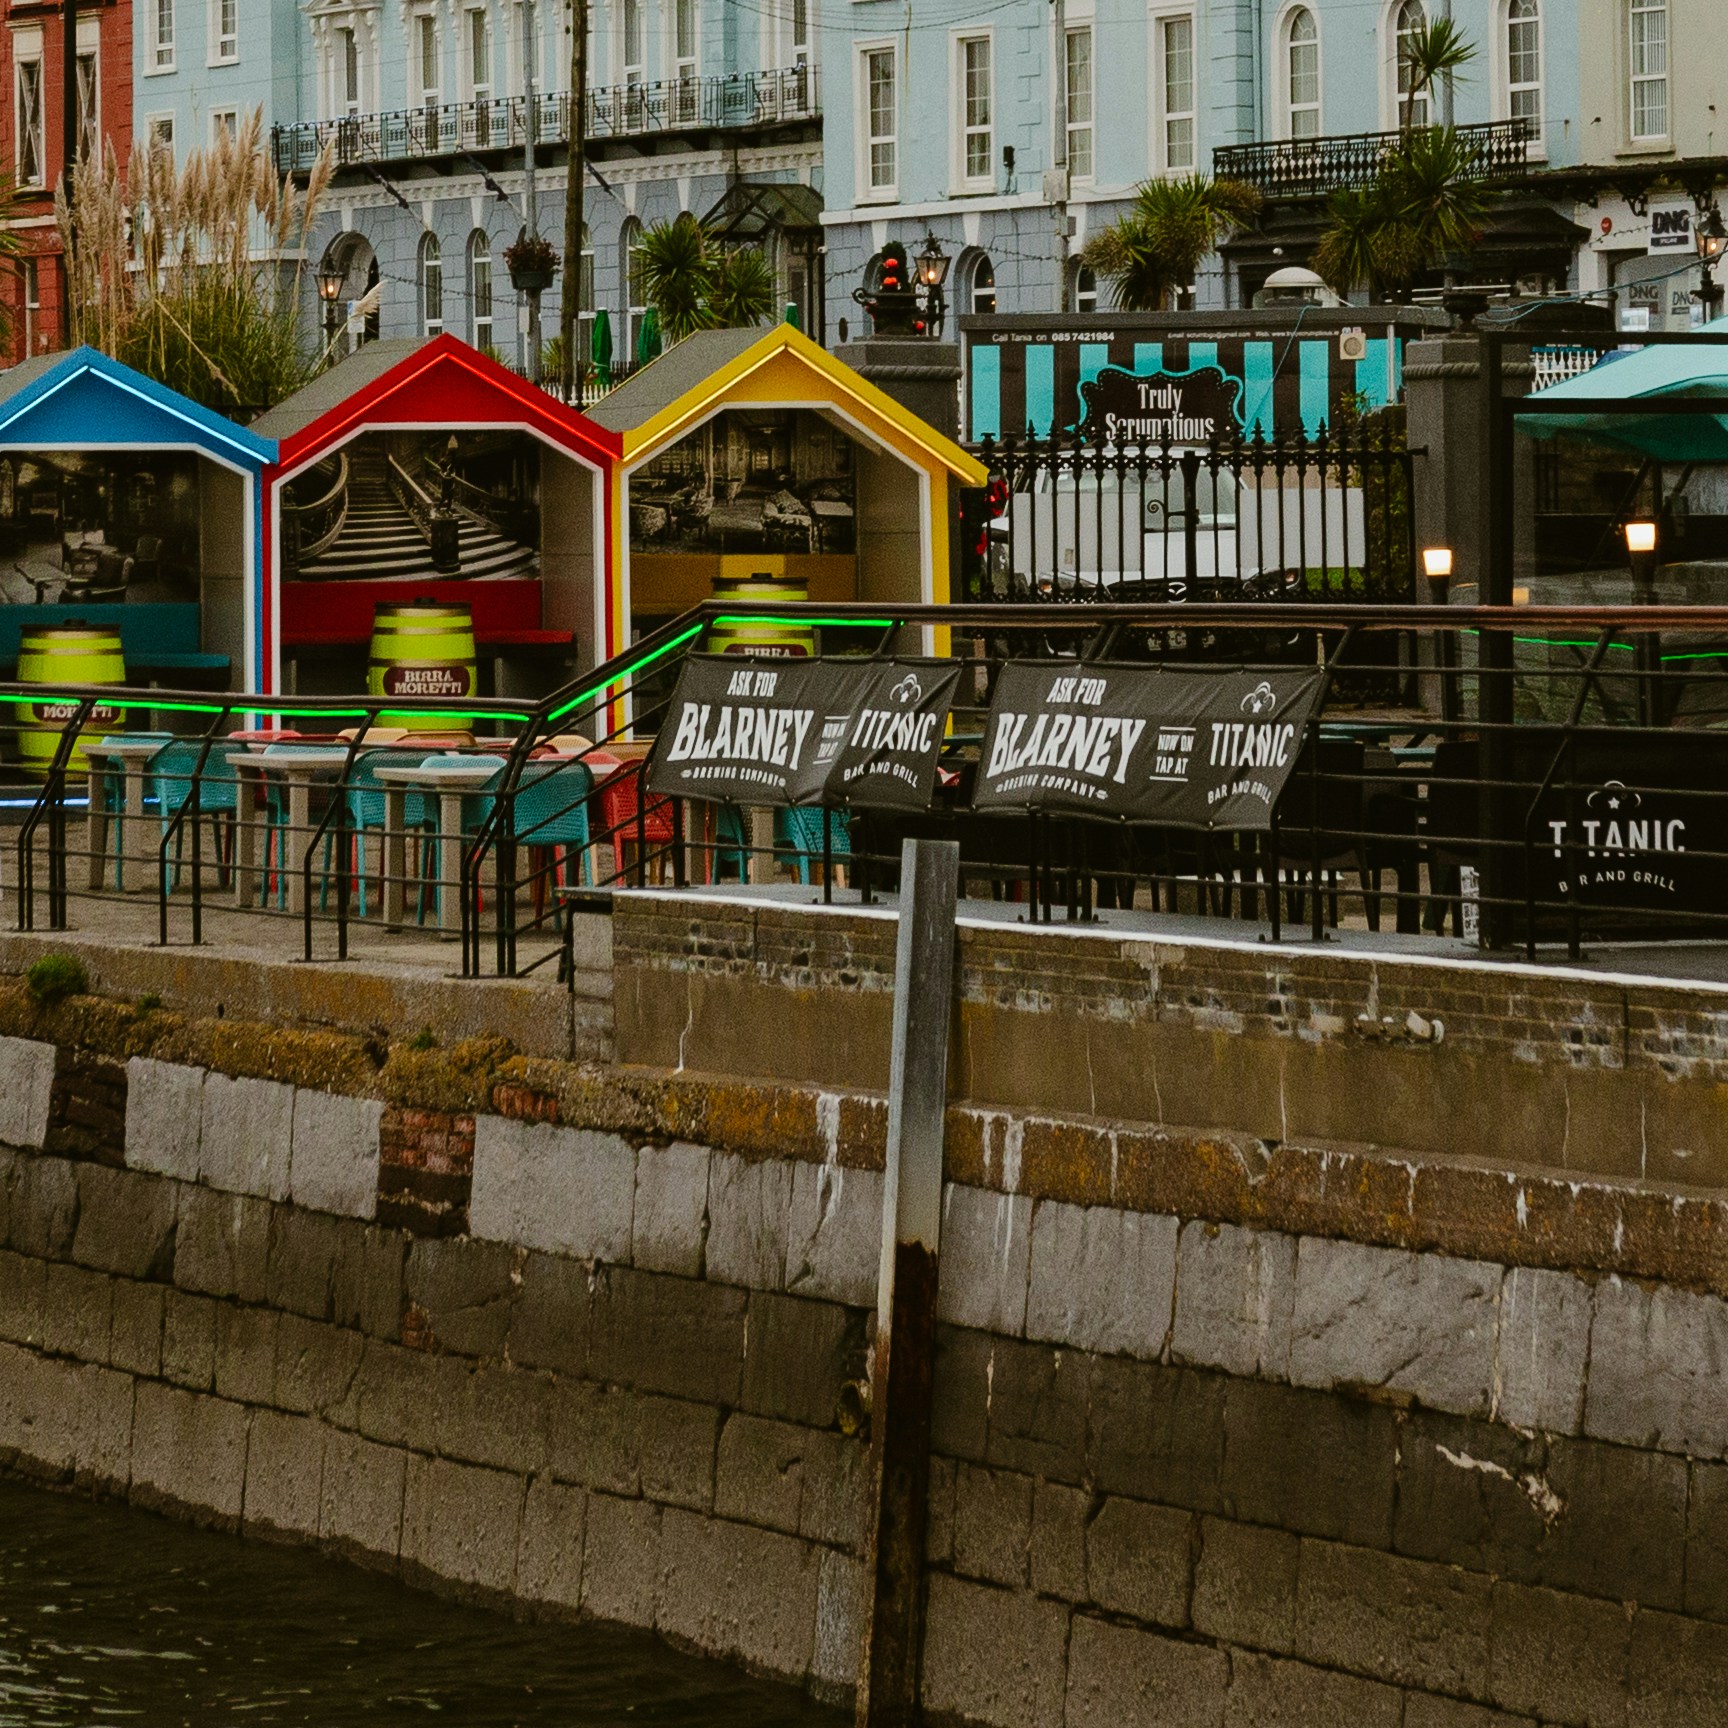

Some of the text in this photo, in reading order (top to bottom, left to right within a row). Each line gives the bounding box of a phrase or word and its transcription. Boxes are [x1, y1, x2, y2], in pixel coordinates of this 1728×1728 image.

[1652, 209, 1690, 234] DNG
[1629, 284, 1659, 300] DNG
[1672, 290, 1695, 305] DNG
[992, 333, 1008, 342] Call
[1035, 334, 1048, 342] on
[1051, 333, 1071, 342] 085
[1137, 383, 1183, 415] Truly
[394, 681, 462, 694] MORETTI
[404, 670, 453, 683] BIRRA
[727, 671, 778, 697] ASK FOR
[1046, 677, 1107, 706] ASK FOR
[43, 705, 112, 719] MORTTI
[667, 702, 814, 770] BLARNEY
[851, 708, 937, 754] TITANIC
[1157, 734, 1194, 752] NOW ON
[986, 713, 1147, 784] BLARNEY
[1210, 722, 1294, 767] TITANIC
[692, 766, 779, 787] BREWING COMPANY
[844, 761, 919, 789] BAR AND GRILL
[1155, 756, 1189, 775] TAP AT
[1003, 773, 1097, 799] BREWING COMPANY
[1207, 780, 1272, 805] BAR AND GRILL
[1549, 819, 1686, 858] TTANIC
[1558, 870, 1676, 893] BR AND GRILL
